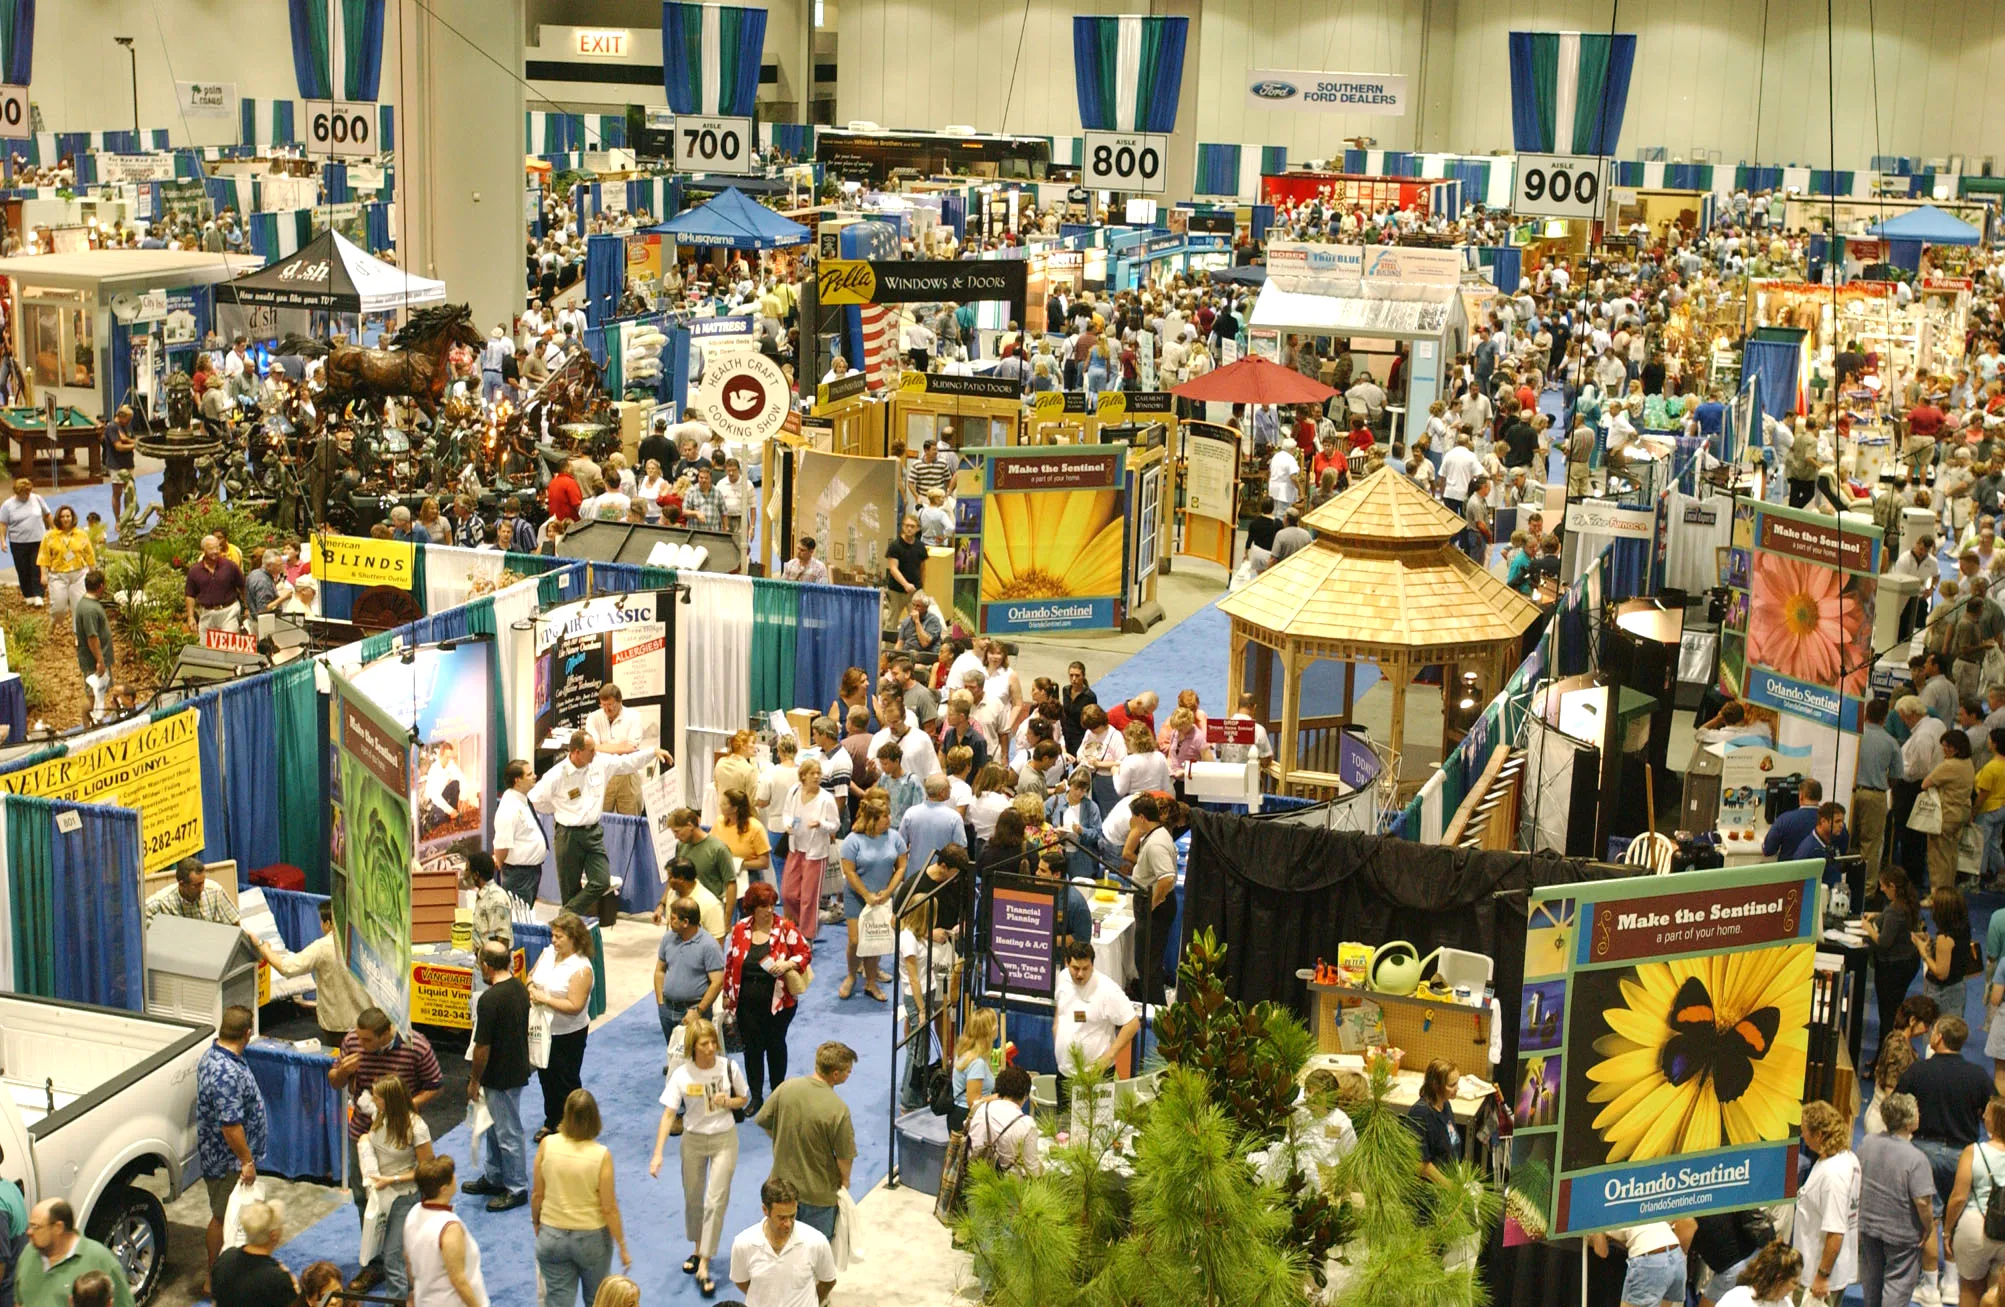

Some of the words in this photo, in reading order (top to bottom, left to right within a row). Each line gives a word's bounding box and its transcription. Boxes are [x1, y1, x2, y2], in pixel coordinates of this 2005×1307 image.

[581, 35, 622, 53] EXIT
[1259, 83, 1289, 97] Ford
[1304, 92, 1337, 102] FORD
[1340, 94, 1396, 104] DEALERS
[1317, 82, 1384, 94] SOUTHERN
[313, 113, 369, 144] 600
[702, 122, 722, 130] AISLE
[683, 128, 740, 161] 700
[1092, 144, 1159, 179] 800
[1551, 162, 1574, 170] AISLE
[1524, 168, 1599, 205] 900
[685, 233, 735, 245] Husqvarna
[819, 265, 873, 299] Pella
[952, 276, 965, 289] &
[240, 290, 254, 300] How
[255, 291, 275, 301] would
[702, 320, 747, 334] MATTRESS
[708, 358, 742, 388] HEALTH
[747, 358, 779, 387] CRAFT
[1037, 394, 1063, 410] Pella
[708, 404, 752, 437] COOKING
[756, 403, 781, 434] SHOW
[1008, 463, 1039, 474] Make
[1041, 463, 1059, 474] the
[1061, 462, 1105, 473] Sentinel
[1035, 475, 1046, 484] part
[1054, 475, 1065, 483] your
[1773, 523, 1800, 540] Make
[1801, 531, 1818, 544] the
[1820, 534, 1860, 554] Seninel
[324, 549, 405, 571] BLINDS
[358, 572, 386, 581] Shutters
[388, 575, 408, 583] Outlet
[587, 607, 651, 629] CASSIC
[1008, 606, 1050, 620] Orlando
[1050, 604, 1093, 618] Sentinel
[209, 631, 255, 653] VELUX
[1766, 678, 1804, 701] Orlando
[1804, 688, 1841, 713] Sentinel
[4, 760, 72, 795] NEVER
[78, 740, 131, 776] PAINT
[133, 714, 195, 754] AGAIN!
[84, 771, 130, 797] LIQUID
[131, 755, 171, 777] VINYL
[1006, 904, 1041, 917] Financial
[1006, 913, 1041, 926] Planning
[1616, 912, 1670, 931] Make
[1674, 908, 1706, 924] the
[1709, 898, 1784, 920] Sentinel
[995, 936, 1024, 949] Heating
[1025, 939, 1031, 948] &
[1033, 941, 1049, 950] A/C
[1656, 933, 1662, 943] a
[1664, 930, 1682, 945] part
[1684, 927, 1694, 940] of
[1695, 928, 1715, 944] your
[1716, 923, 1743, 937] home.
[1021, 963, 1039, 973] Tree
[1040, 965, 1046, 974] &
[418, 986, 448, 998] Liquid
[1604, 1171, 1676, 1201] Orlando
[1677, 1159, 1750, 1190] Sentinel
[1640, 1192, 1713, 1214] OrlandoSentinel.com
